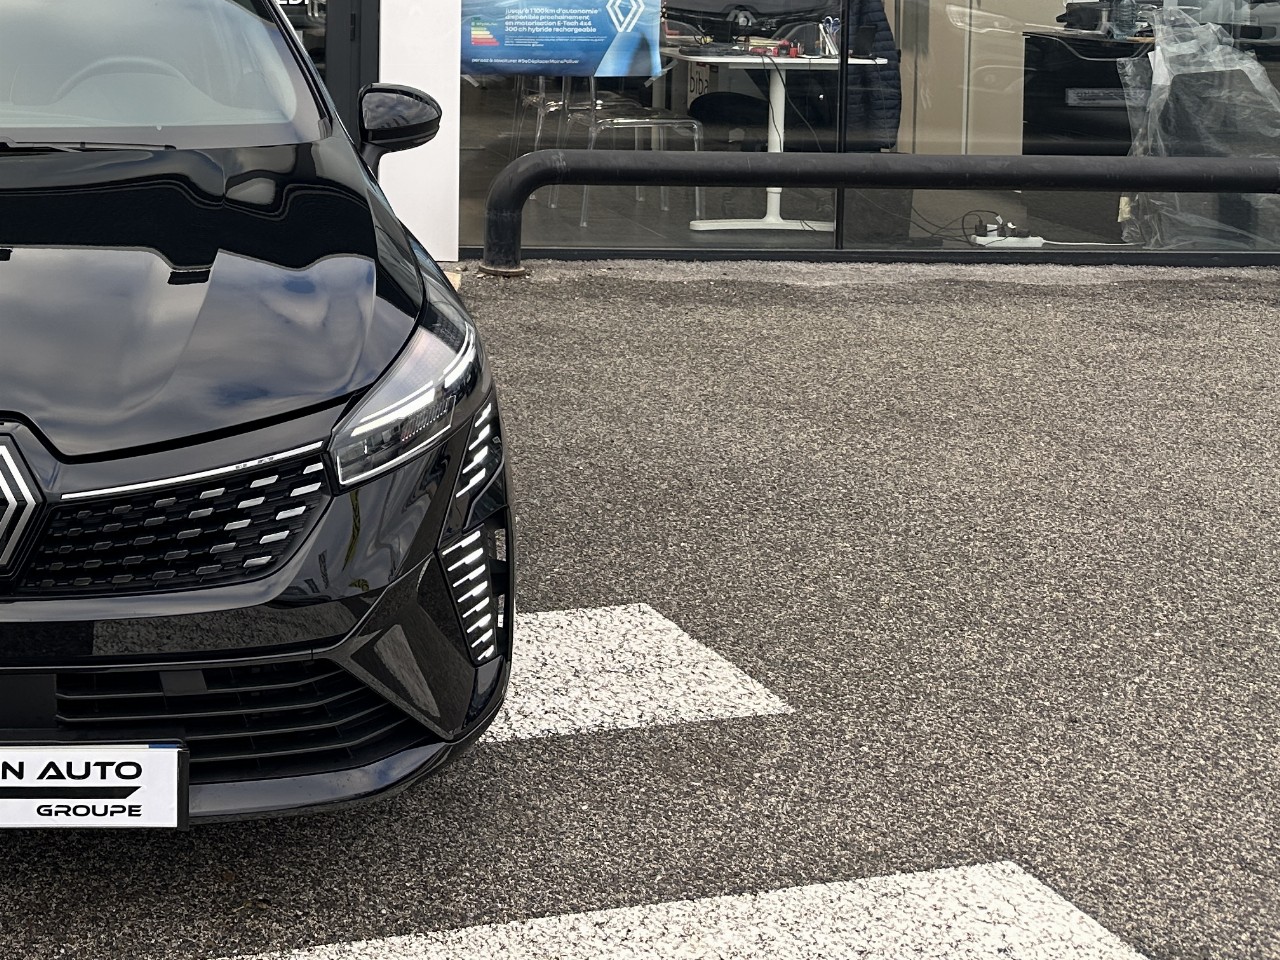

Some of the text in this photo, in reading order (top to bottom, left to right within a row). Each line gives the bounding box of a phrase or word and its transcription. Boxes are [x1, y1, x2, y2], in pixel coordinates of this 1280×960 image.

[528, 26, 552, 34] hybride
[553, 26, 597, 34] rechargeable
[35, 760, 144, 780] AUTO
[35, 804, 144, 818] GROUPE
